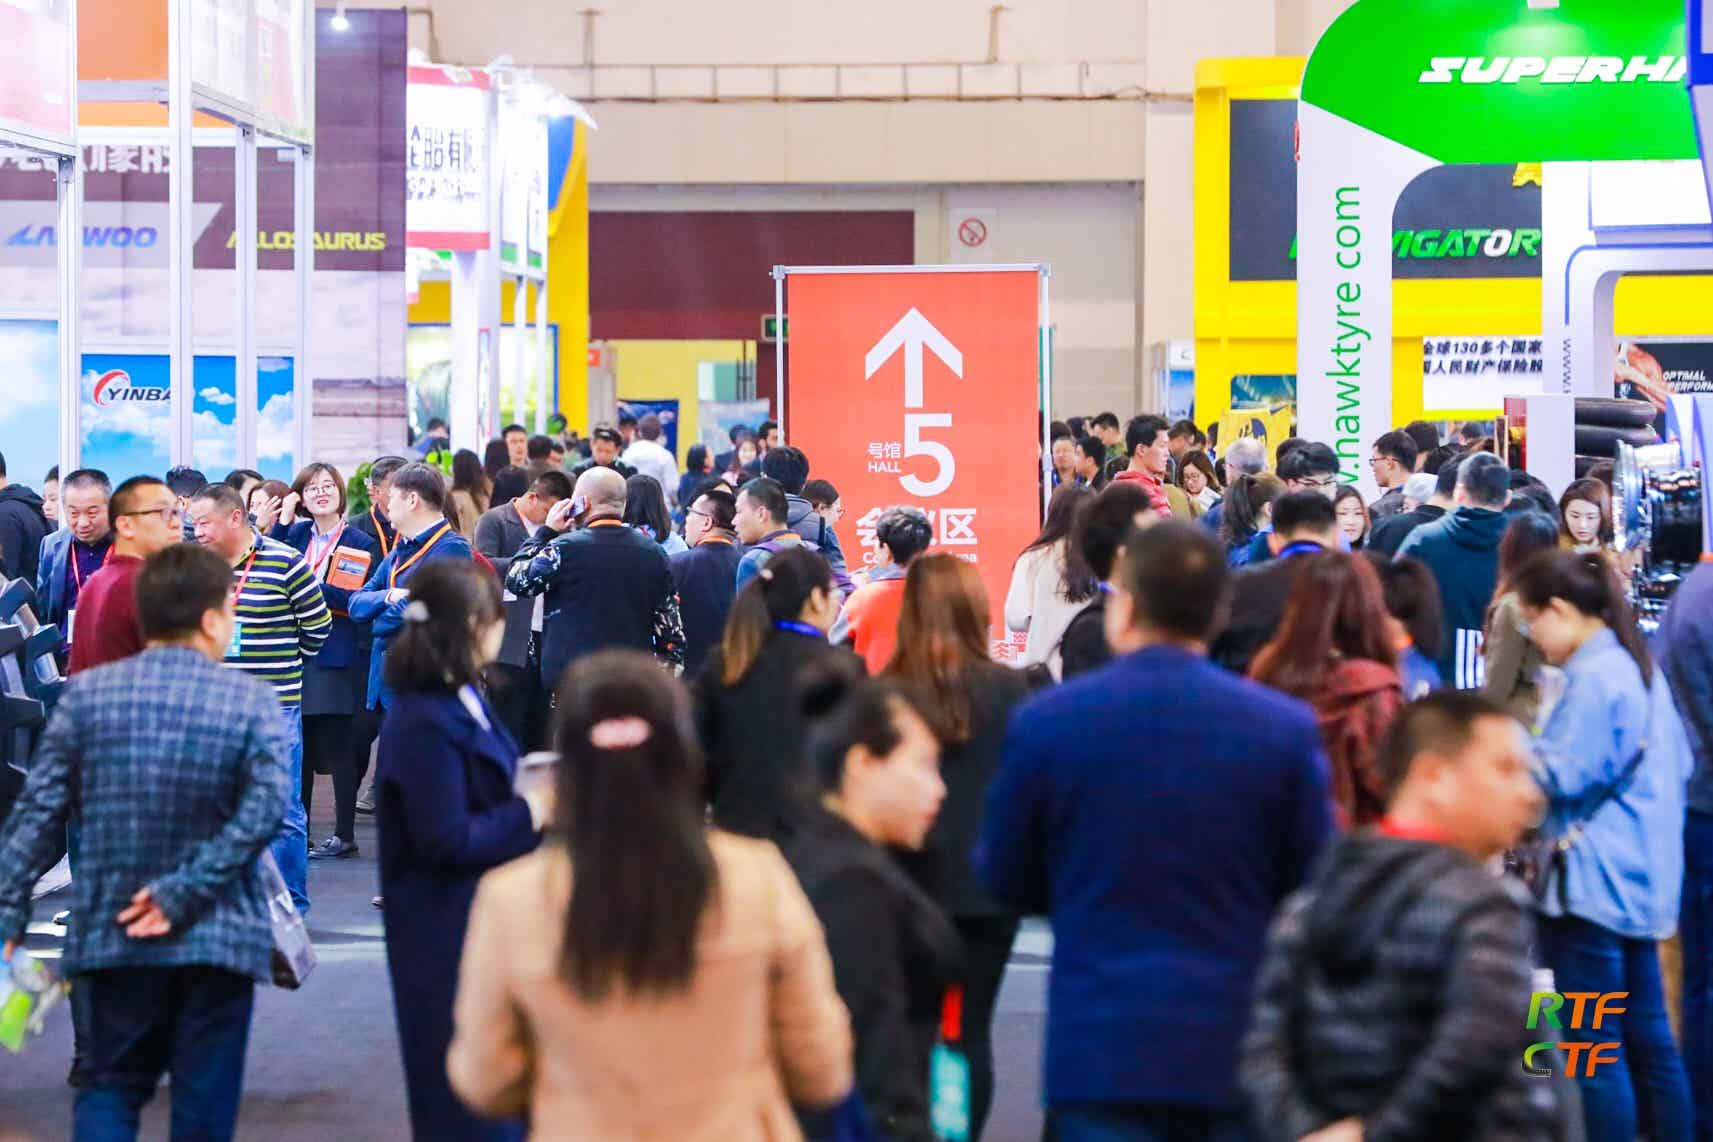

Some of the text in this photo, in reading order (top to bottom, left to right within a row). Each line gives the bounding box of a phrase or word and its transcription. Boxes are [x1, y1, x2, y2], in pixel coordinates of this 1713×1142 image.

[868, 441, 902, 459] 号馆
[899, 413, 956, 497] 5
[868, 461, 902, 473] HALL
